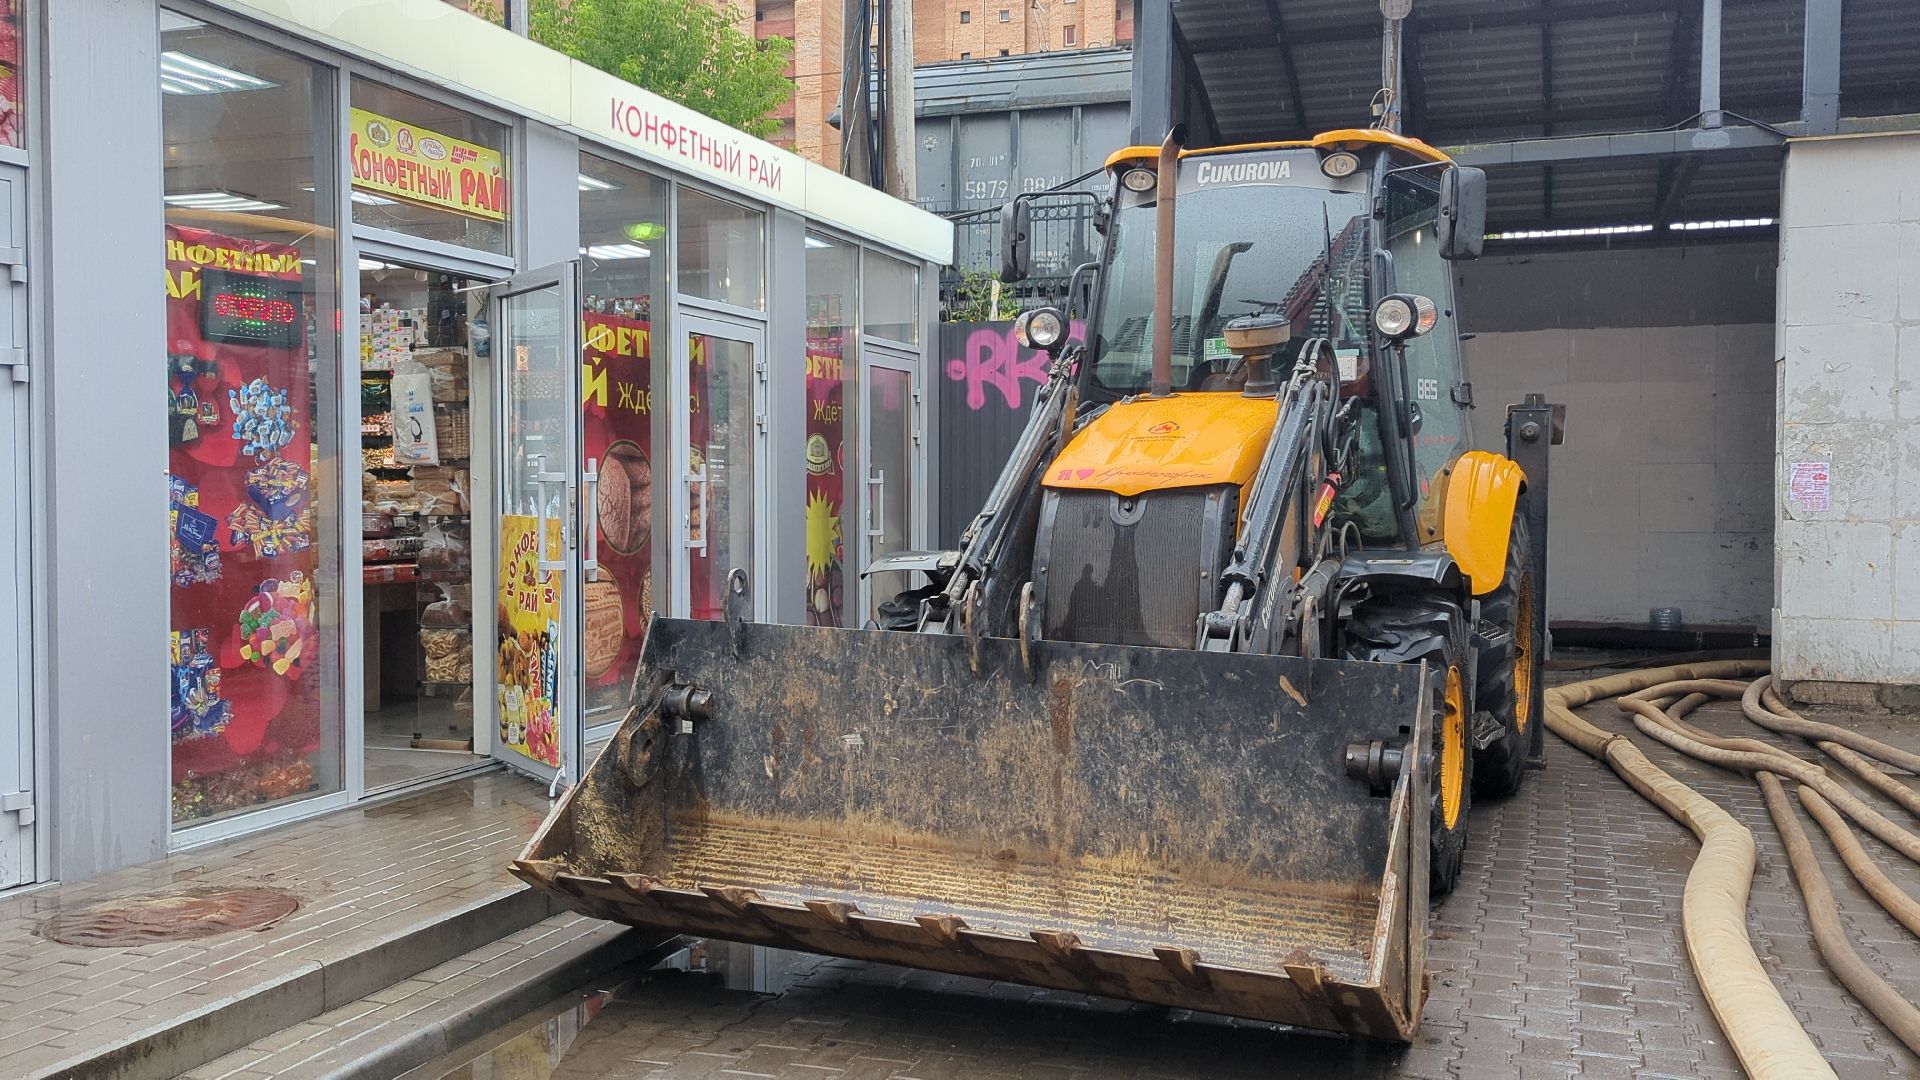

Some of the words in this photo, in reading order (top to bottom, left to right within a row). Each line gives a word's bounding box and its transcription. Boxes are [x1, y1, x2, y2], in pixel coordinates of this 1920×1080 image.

[611, 97, 742, 177] КОНФЕТНЫЙ
[749, 154, 782, 192] РАЙ
[965, 180, 1008, 199] 5879
[214, 293, 295, 323] ОТКРЫТО
[518, 588, 538, 613] РАЙ
